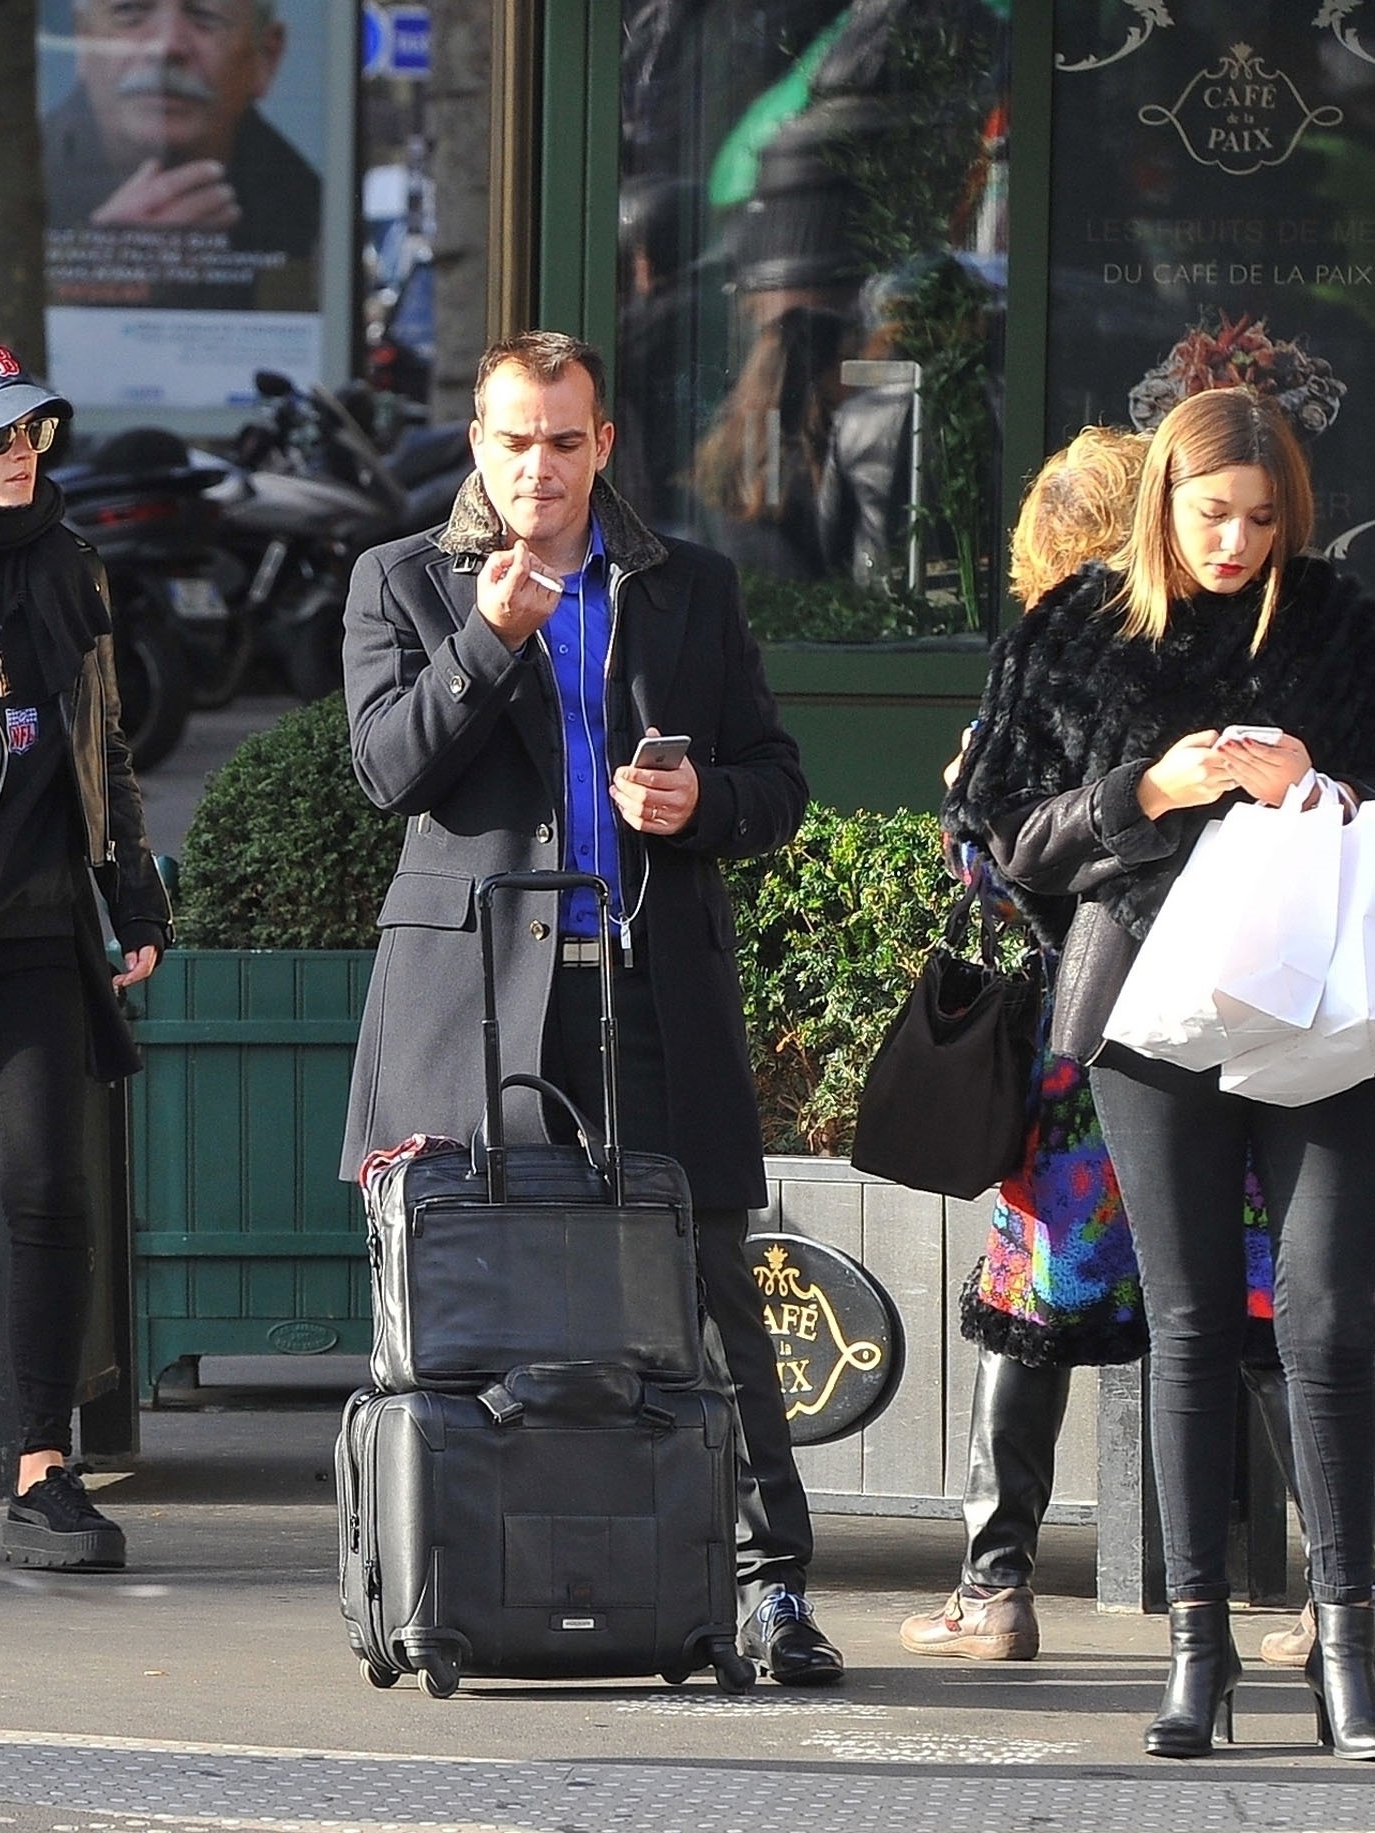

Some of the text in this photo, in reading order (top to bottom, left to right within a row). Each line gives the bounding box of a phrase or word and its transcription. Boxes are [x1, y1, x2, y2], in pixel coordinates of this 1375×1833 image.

[1203, 84, 1277, 109] CAFÉ
[1226, 112, 1254, 124] de la
[1208, 127, 1273, 153] PAIX
[1156, 220, 1265, 242] FRUITS
[1279, 220, 1319, 242] DE
[1104, 259, 1374, 285] DU CAFÉ DE LA PAIX
[11, 724, 34, 748] NFL
[763, 1302, 819, 1342] AFÉ
[780, 1340, 793, 1356] la
